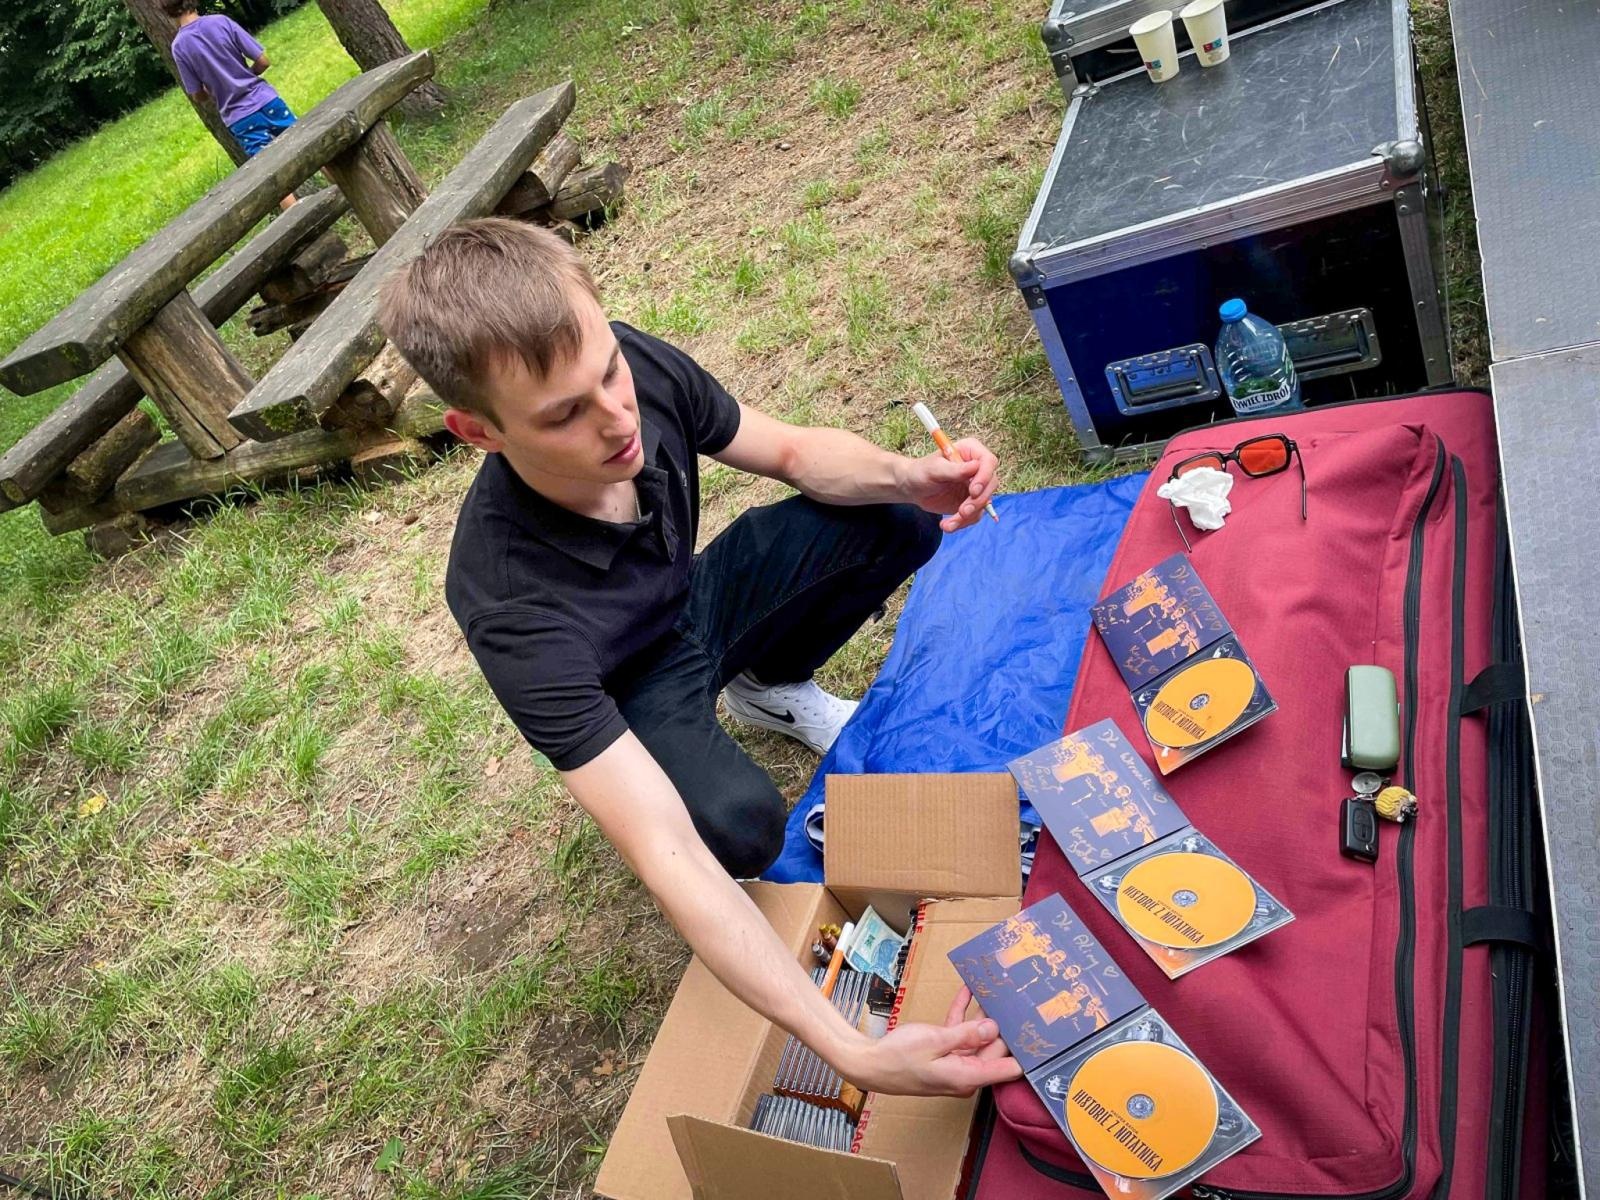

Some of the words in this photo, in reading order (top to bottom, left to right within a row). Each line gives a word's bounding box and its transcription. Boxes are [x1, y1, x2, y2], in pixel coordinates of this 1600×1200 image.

[1153, 701, 1178, 721] HISTORIE
[1172, 713, 1183, 723] Z
[1176, 717, 1207, 740] NOTATNIKA
[1122, 885, 1159, 911] HISTORIE
[1153, 907, 1165, 916] Z
[1160, 911, 1205, 944] NOTATNIKA
[1072, 1089, 1113, 1127] HISTORIE
[1106, 1119, 1120, 1133] Z
[1113, 1126, 1164, 1172] NOTATNIKA
